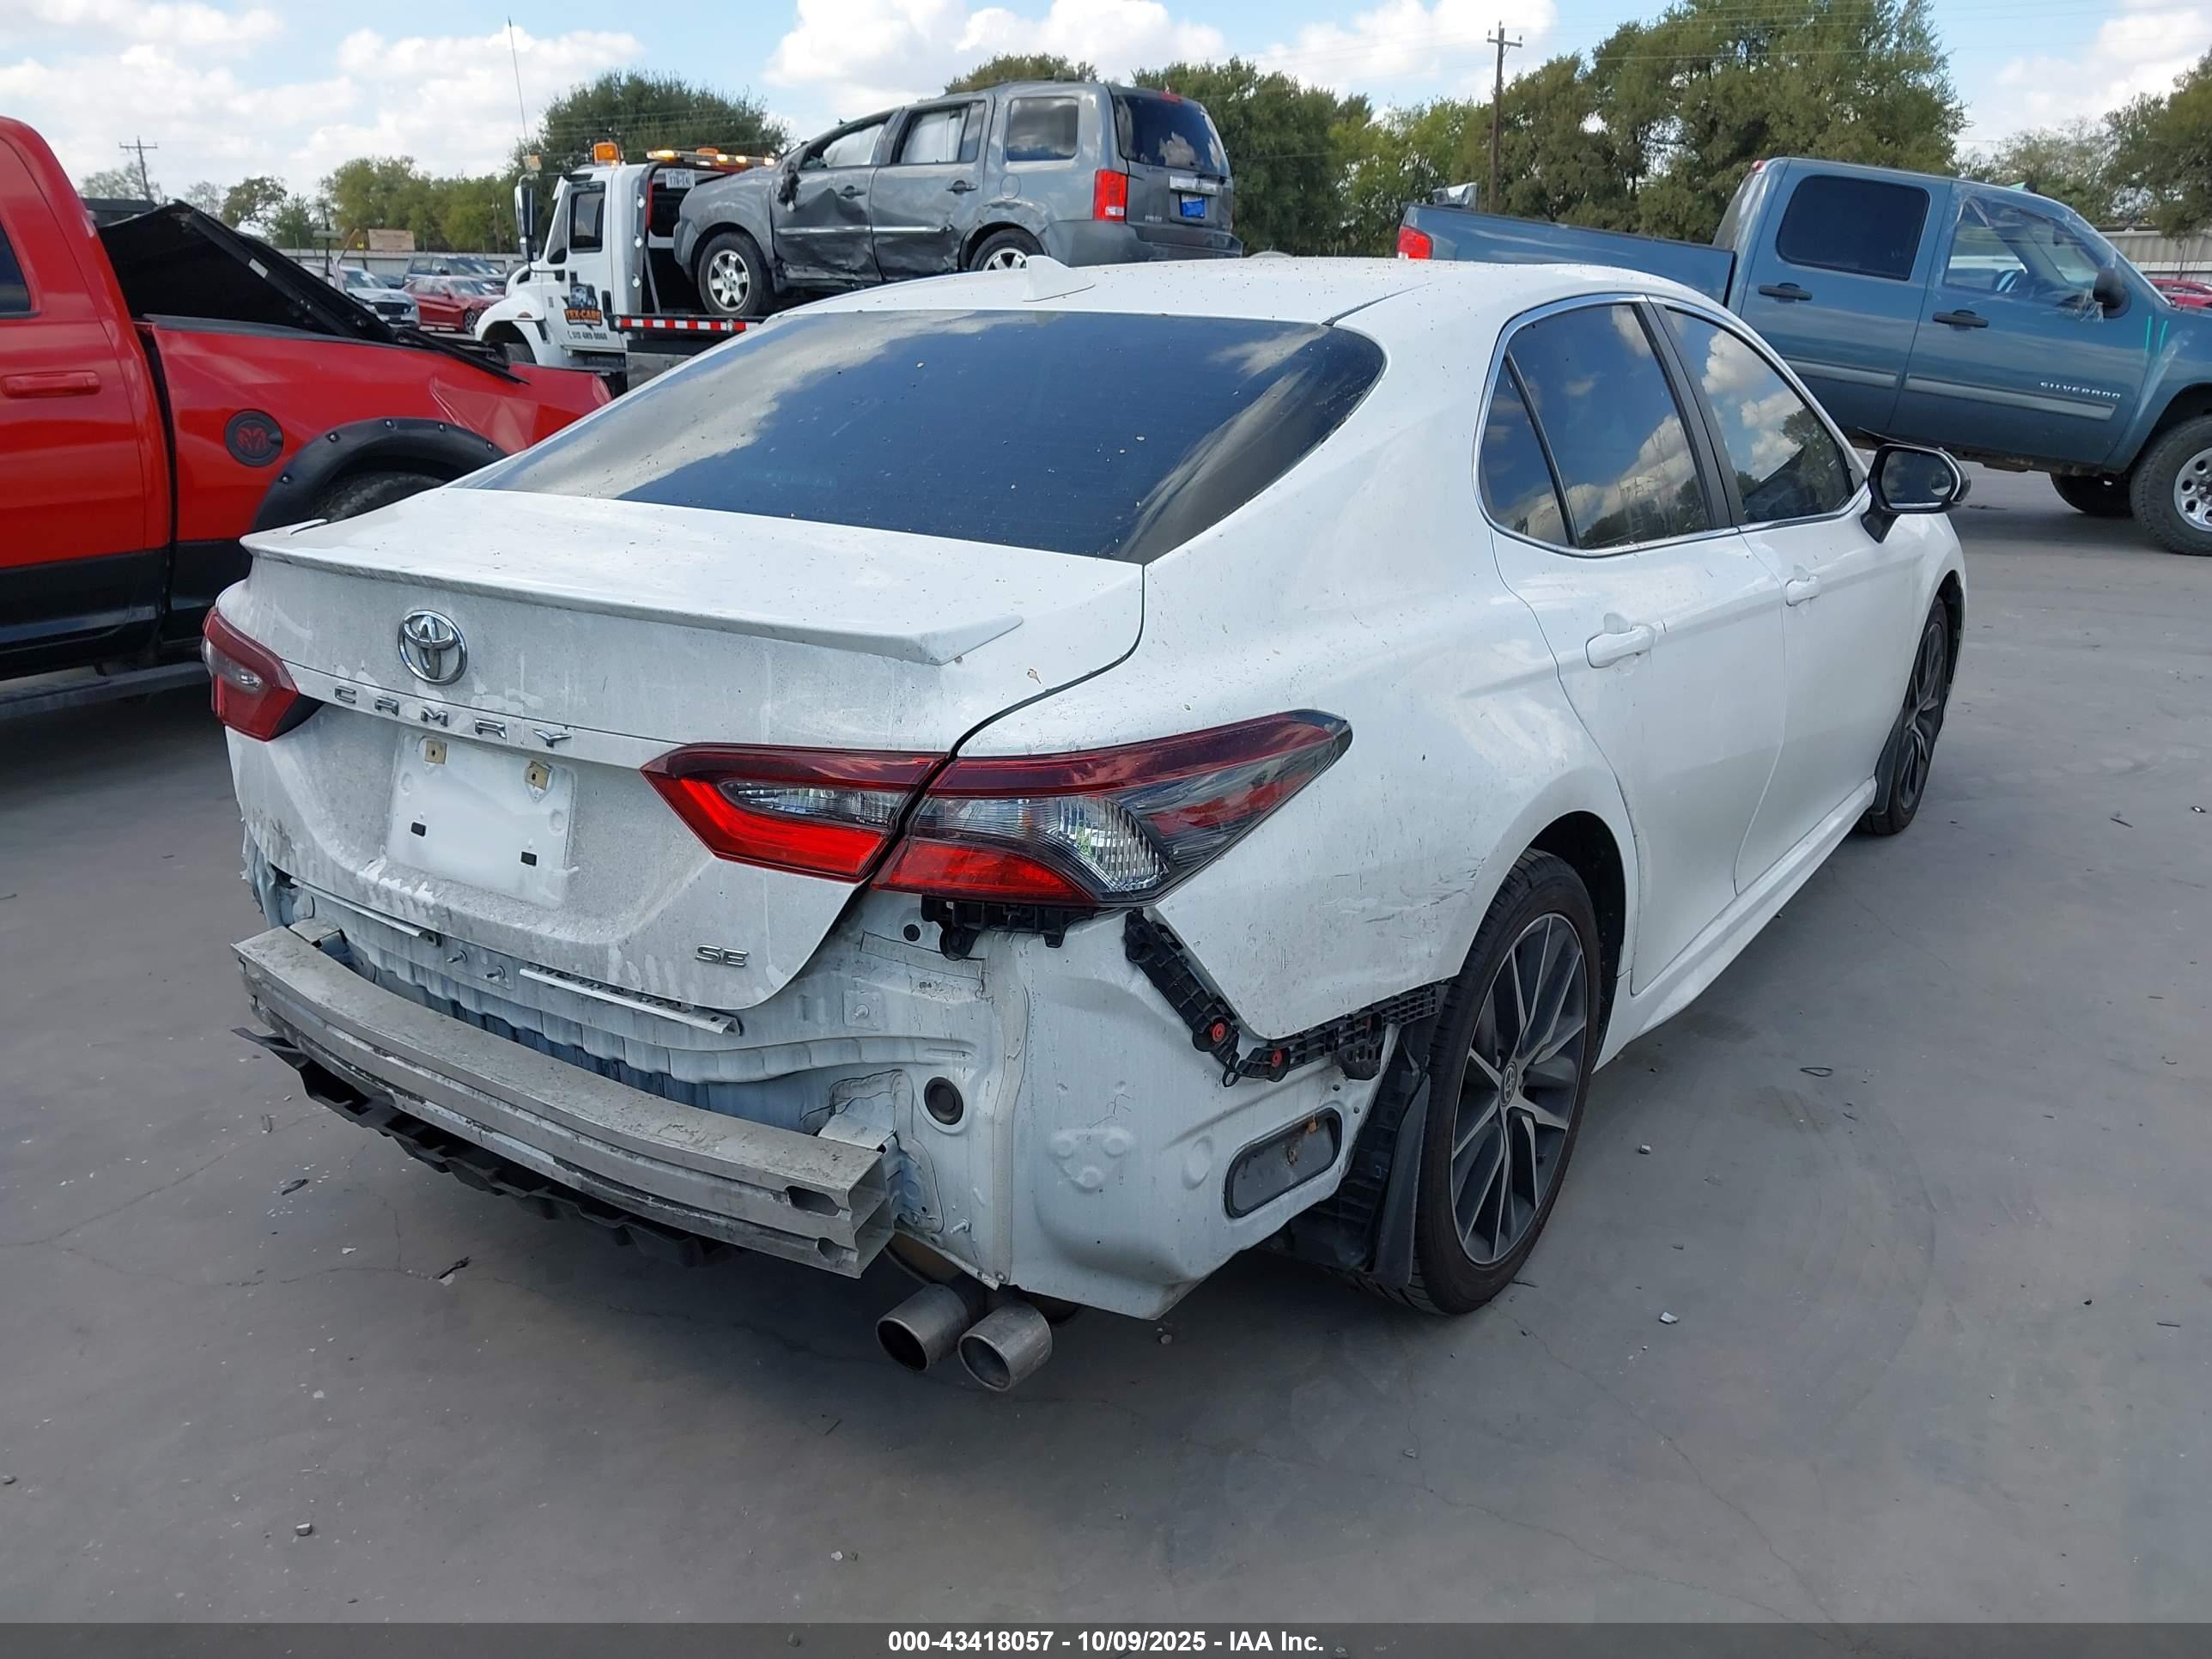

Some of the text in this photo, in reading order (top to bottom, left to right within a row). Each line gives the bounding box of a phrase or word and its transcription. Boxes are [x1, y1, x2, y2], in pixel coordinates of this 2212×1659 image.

[2039, 381, 2121, 398] SILVERADO
[334, 685, 572, 748] CAMRY
[695, 945, 749, 968] SE
